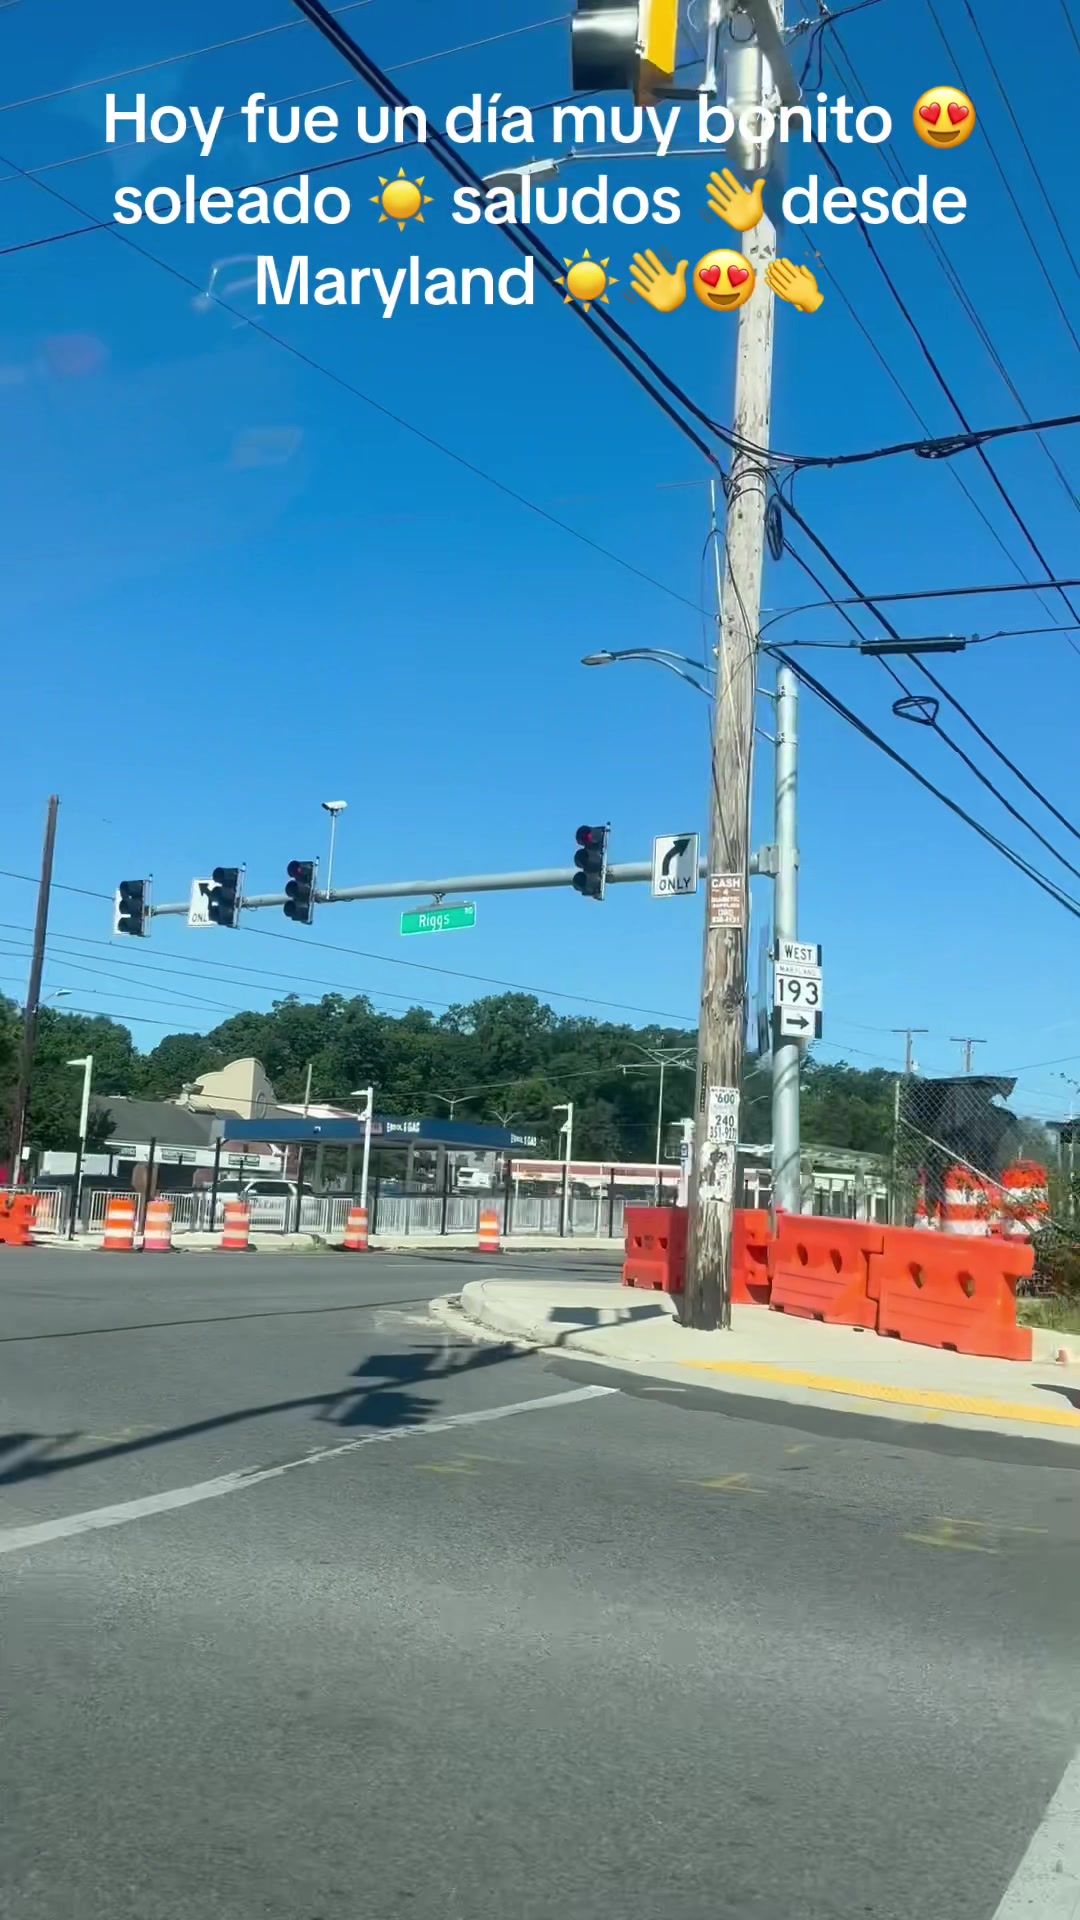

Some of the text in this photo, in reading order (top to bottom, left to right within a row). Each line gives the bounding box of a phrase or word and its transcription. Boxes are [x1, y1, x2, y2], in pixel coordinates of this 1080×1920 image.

[659, 876, 691, 891] ONLY
[711, 878, 740, 888] CASH
[191, 912, 209, 923] ONL
[419, 912, 450, 931] Riggs
[784, 944, 812, 961] WEST
[778, 978, 819, 1005] 193
[715, 1114, 735, 1127] 240
